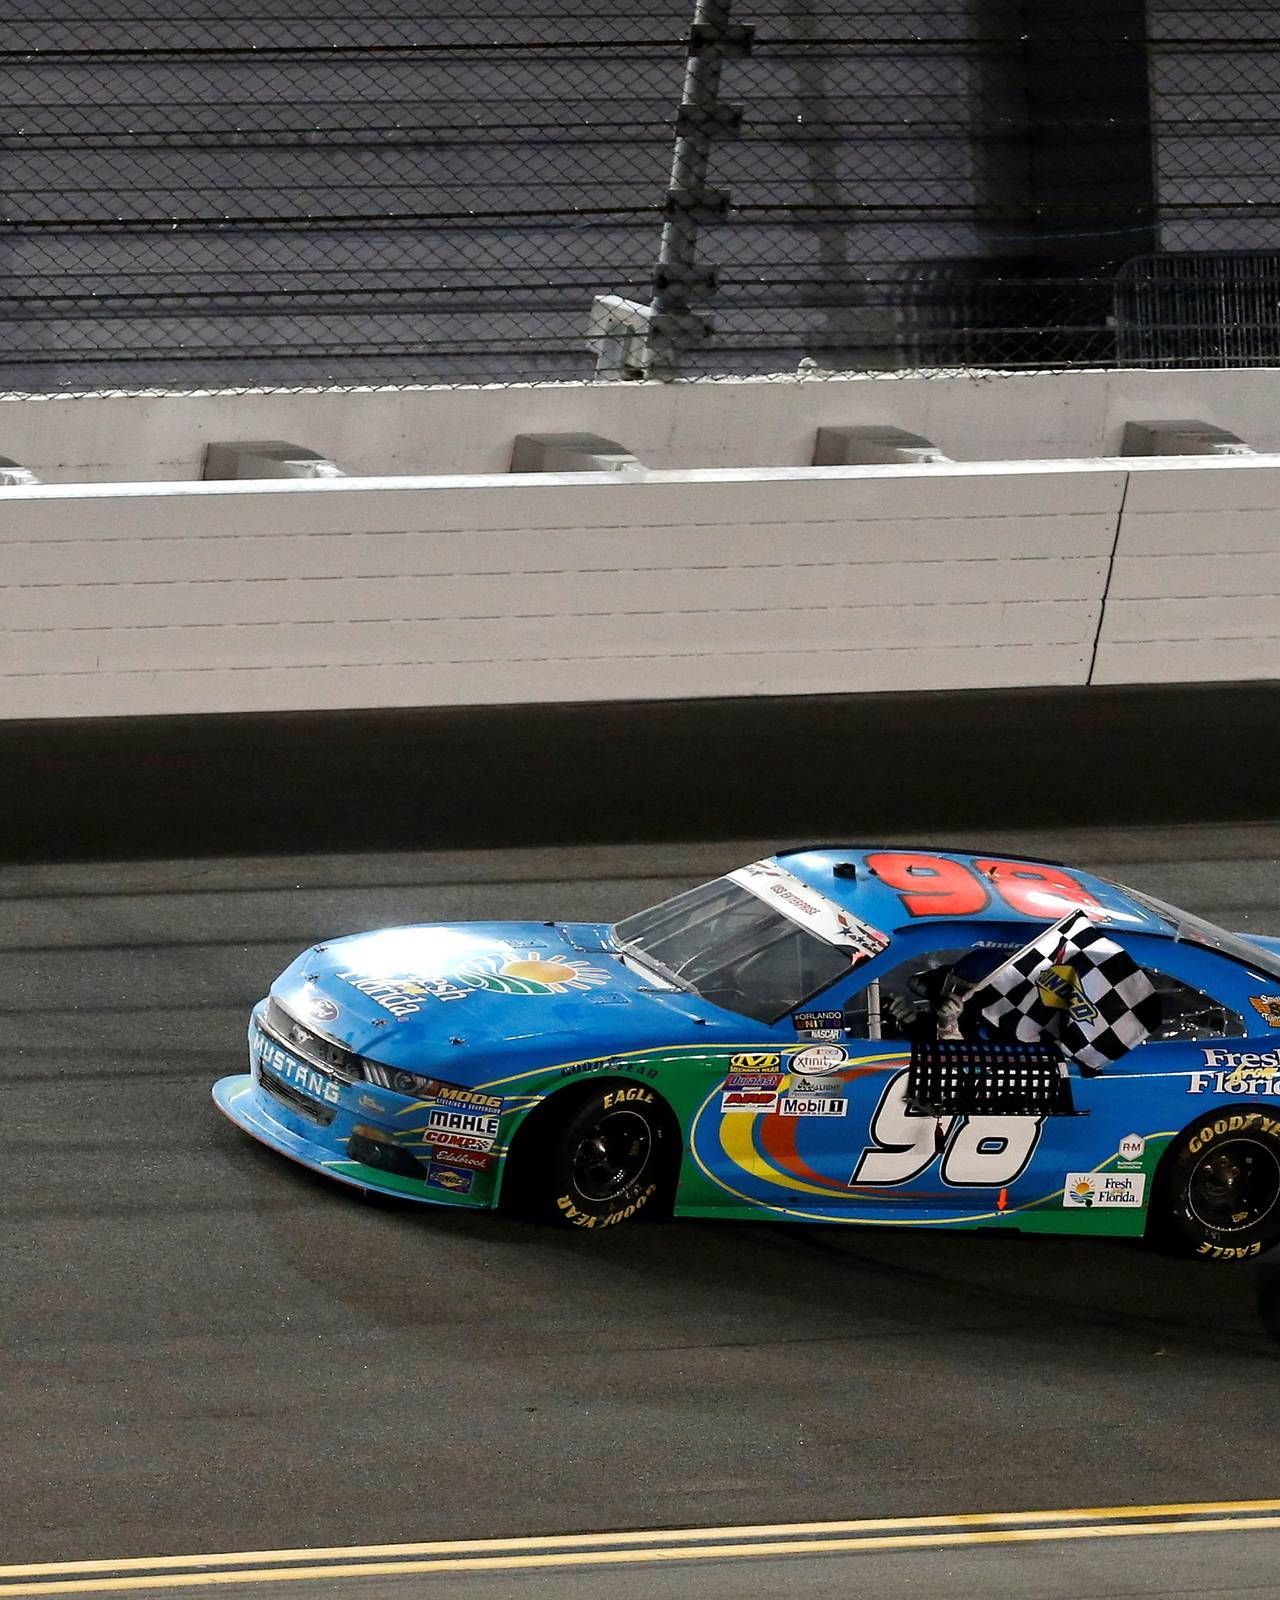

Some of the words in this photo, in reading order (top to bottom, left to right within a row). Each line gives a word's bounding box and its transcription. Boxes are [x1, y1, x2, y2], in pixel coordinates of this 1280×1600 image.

[863, 853, 1107, 922] 98
[811, 1029, 840, 1040] NASCAR
[254, 1032, 341, 1104] MUSTANG
[730, 1075, 776, 1086] Duralast
[438, 1087, 503, 1107] MOOG
[603, 1088, 655, 1110] EAGLE
[784, 1100, 825, 1113] Mobil
[430, 1111, 498, 1133] MAHLE
[436, 1151, 487, 1168] Edelbrock
[1105, 1178, 1132, 1189] Fresh
[1098, 1191, 1135, 1203] Florida
[1196, 1241, 1261, 1260] EAGLE
